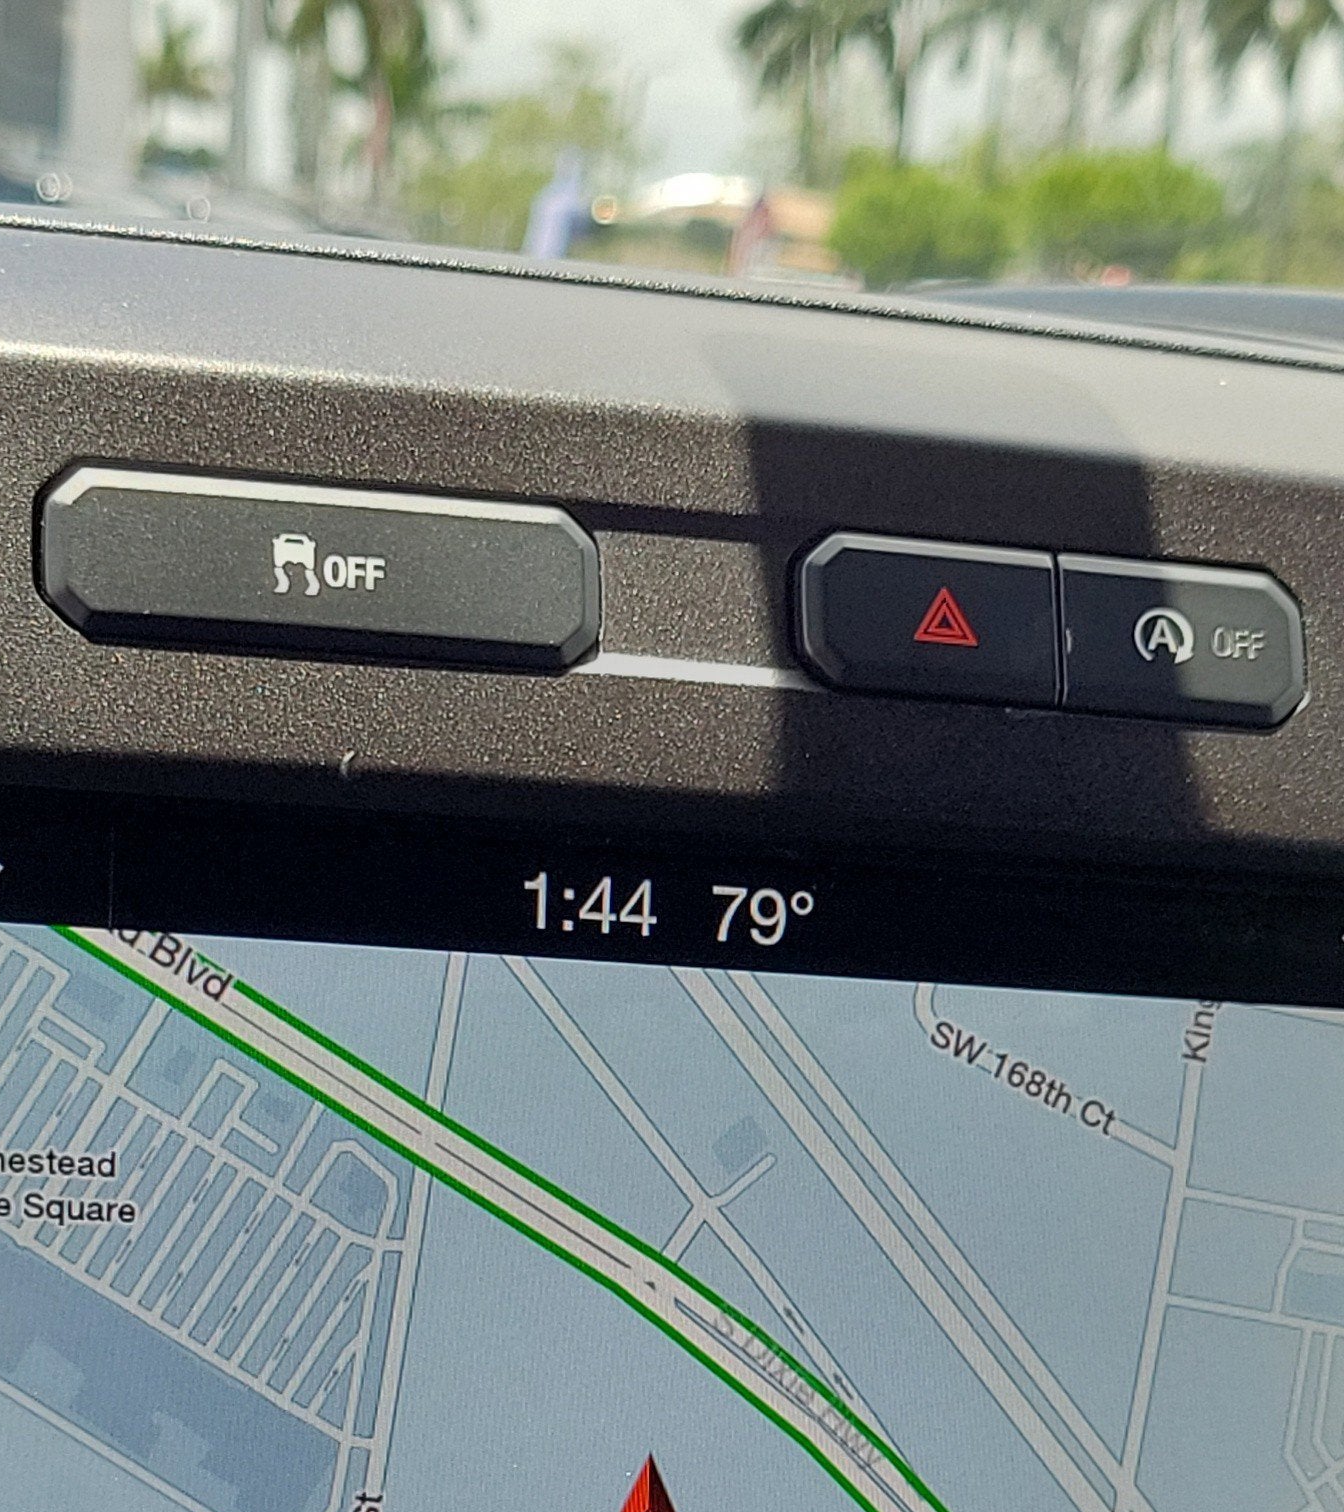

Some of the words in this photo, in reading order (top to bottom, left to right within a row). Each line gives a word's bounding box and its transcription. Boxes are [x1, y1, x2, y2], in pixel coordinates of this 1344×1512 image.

[322, 554, 386, 591] OFF
[1212, 626, 1266, 661] OFF
[523, 871, 656, 938] 1:44
[711, 884, 816, 947] 79°
[149, 932, 234, 1002] Blvd
[930, 1021, 988, 1066] SW
[990, 1053, 1073, 1115] 168th
[1079, 1100, 1116, 1136] Ct
[22, 1192, 136, 1226] Square
